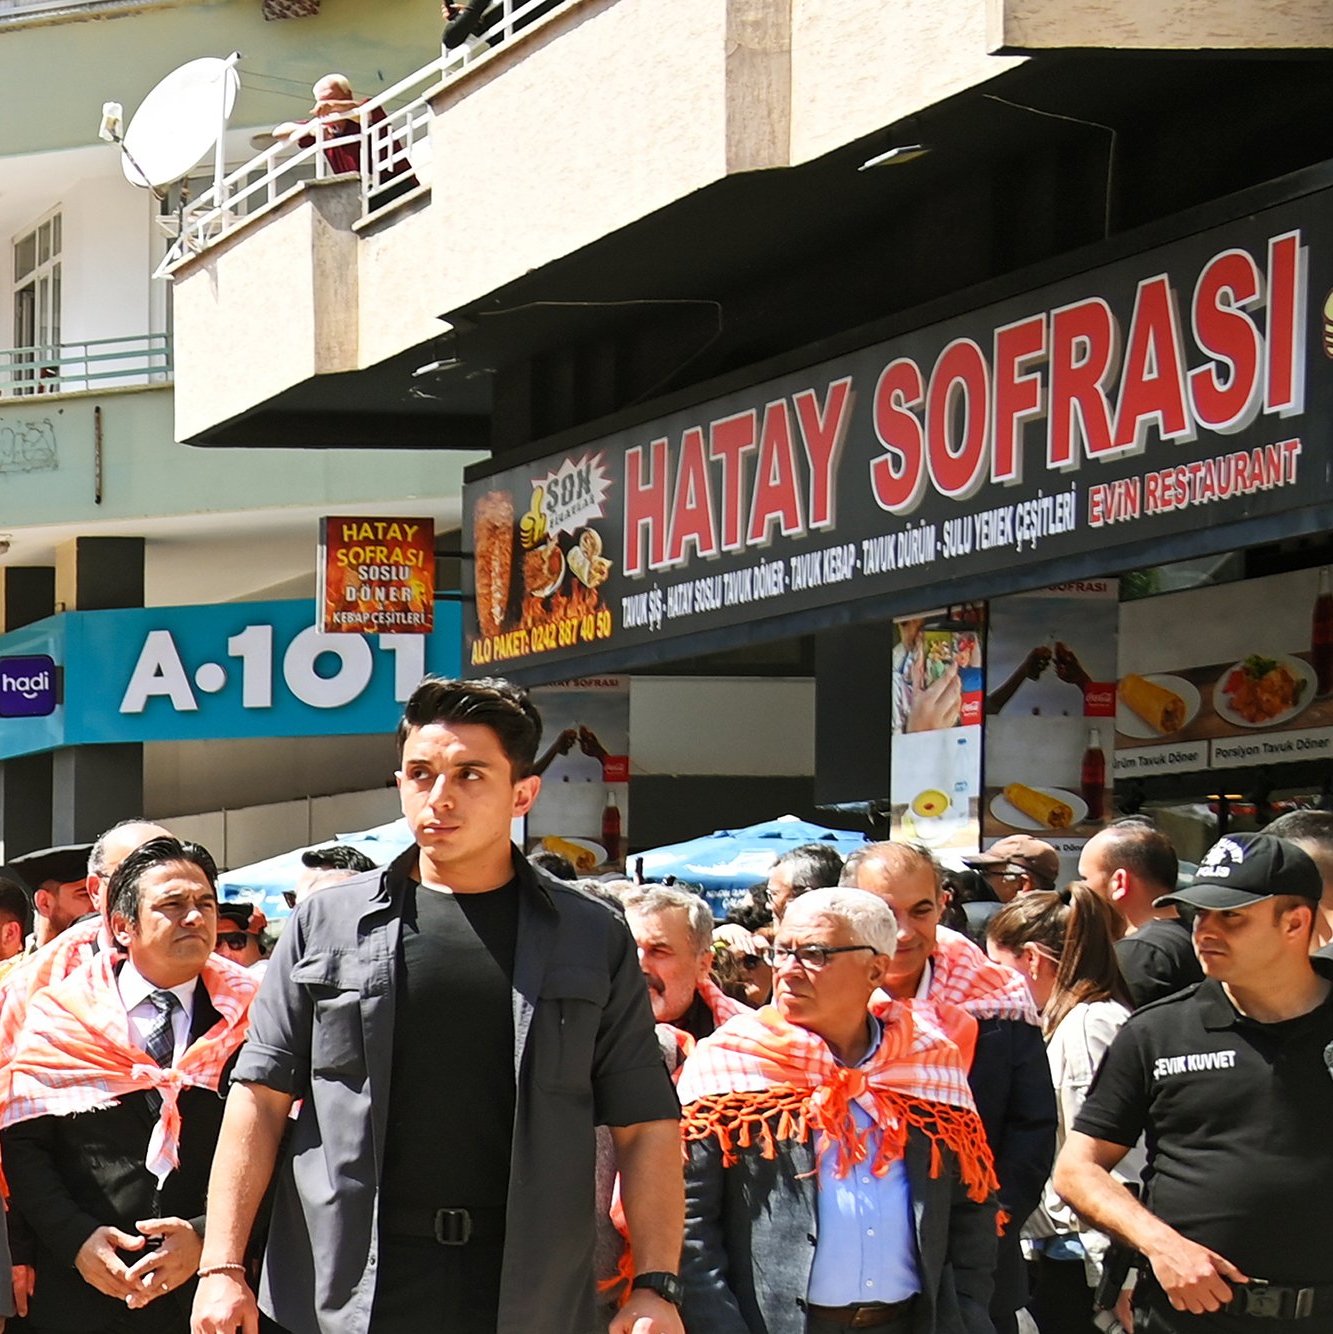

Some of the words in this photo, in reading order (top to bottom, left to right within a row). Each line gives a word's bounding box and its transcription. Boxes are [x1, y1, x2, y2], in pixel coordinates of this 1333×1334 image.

[623, 376, 853, 577] HATAY
[869, 229, 1302, 513] SOFRASI
[1144, 438, 1302, 517] RESTAURANT
[342, 522, 419, 543] HATAY
[336, 546, 425, 568] SOFRASI
[622, 592, 648, 629] TAVUK
[648, 582, 663, 632] ŞİŞ
[667, 581, 694, 619] HATAY
[694, 574, 722, 613] SOSLU
[723, 568, 753, 606] TAVUK
[753, 557, 785, 600] DÖNER
[790, 550, 822, 592] TAVUK
[823, 543, 856, 584] KEBAP
[862, 534, 897, 576] TAVUK
[897, 518, 936, 568] DÜRÜM
[943, 516, 973, 559] SULU
[974, 505, 1015, 551] YEMEK
[1015, 481, 1077, 553] ÇEŞİTLERİ
[358, 565, 411, 581] SOSLU
[345, 583, 413, 602] DÖNER
[333, 611, 370, 624] KEBAP
[471, 637, 493, 666] ALO
[493, 629, 530, 661] PAKET:
[531, 623, 557, 653] 0242
[558, 618, 578, 647] 887
[580, 613, 596, 642] 40
[596, 609, 612, 639] 50
[2, 671, 49, 692] hadi
[1139, 753, 1166, 766] Tavuk
[1168, 751, 1199, 764] Döner
[1215, 745, 1260, 758] Porsiyon
[1262, 741, 1293, 754] Tavuk
[1296, 738, 1329, 751] Döner
[1187, 1050, 1237, 1073] KUVVET
